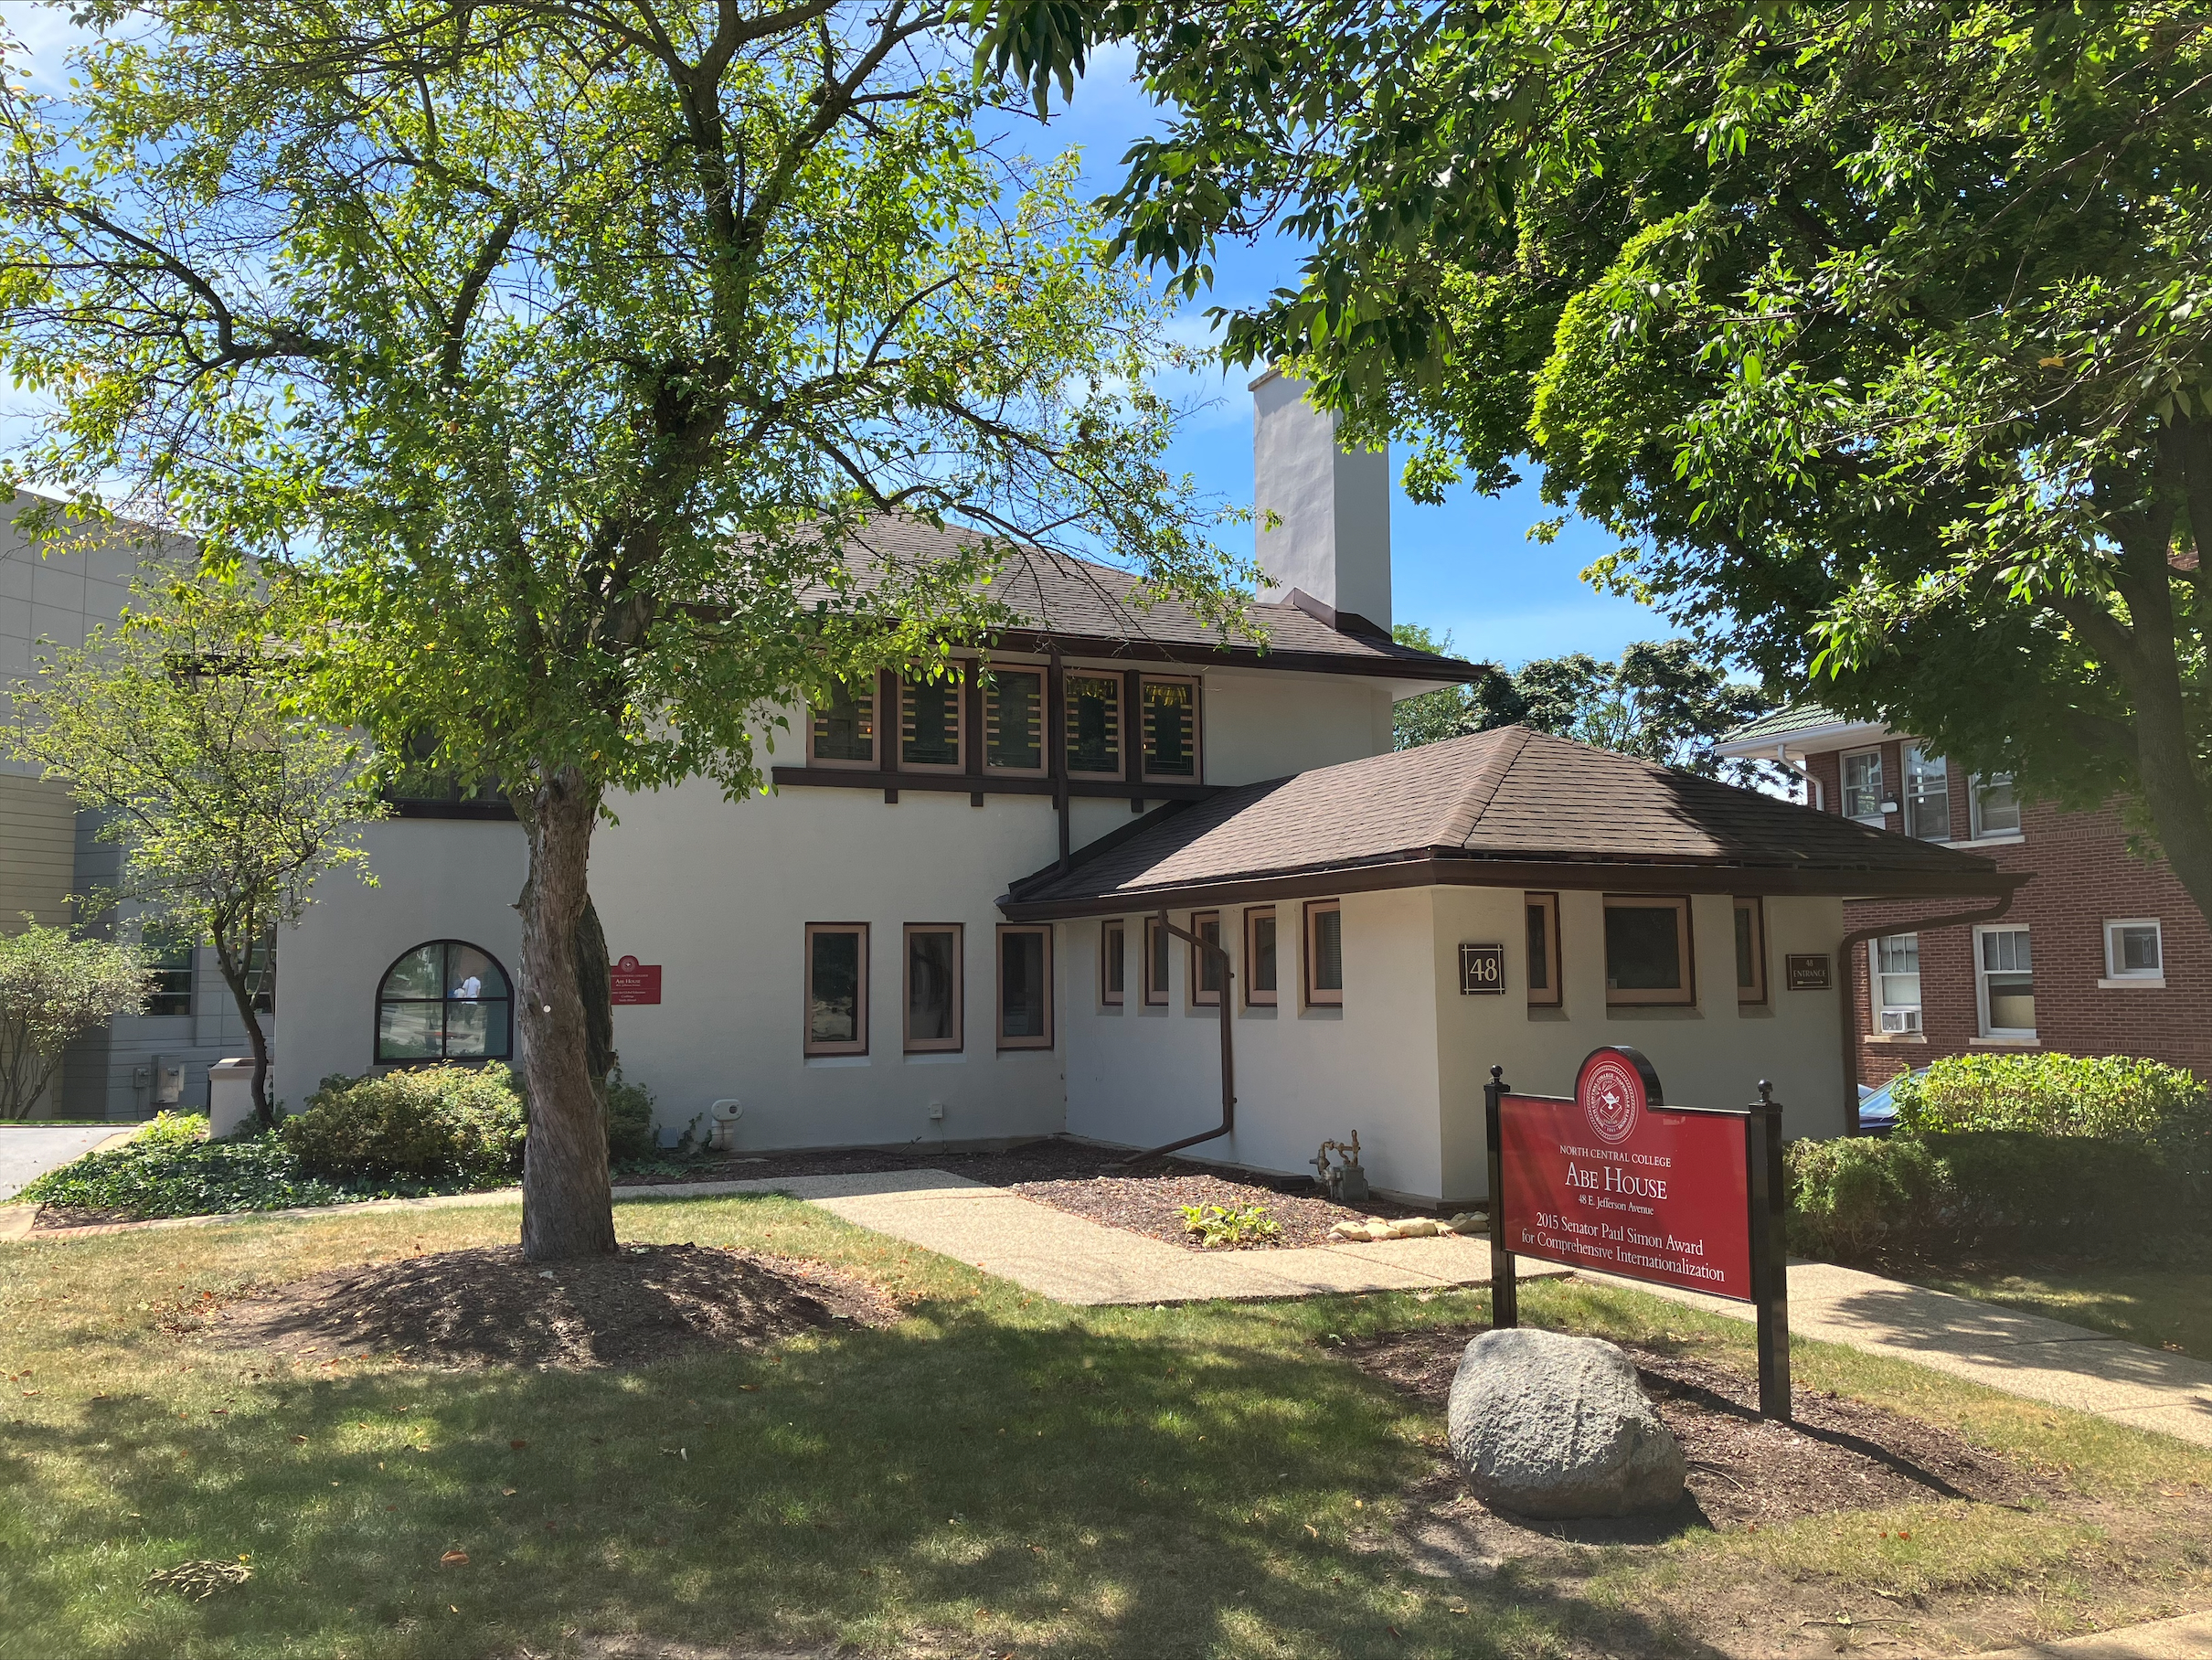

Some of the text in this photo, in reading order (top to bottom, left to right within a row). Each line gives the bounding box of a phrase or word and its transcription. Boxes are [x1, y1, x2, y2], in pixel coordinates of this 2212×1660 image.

[1469, 957, 1498, 982] 48
[1792, 969, 1826, 978] ENTRANCE
[1805, 959, 1814, 967] 48
[1559, 1144, 1672, 1167] NORTH CENTRAL COLLEGE
[1565, 1161, 1667, 1200] ABE HOUSE
[1578, 1194, 1654, 1216] 48 E. Jefferson Avenue
[1536, 1211, 1704, 1256] 2015 Senator Paul Simon Award
[1521, 1228, 1725, 1282] for Comprehensive Internationalization
